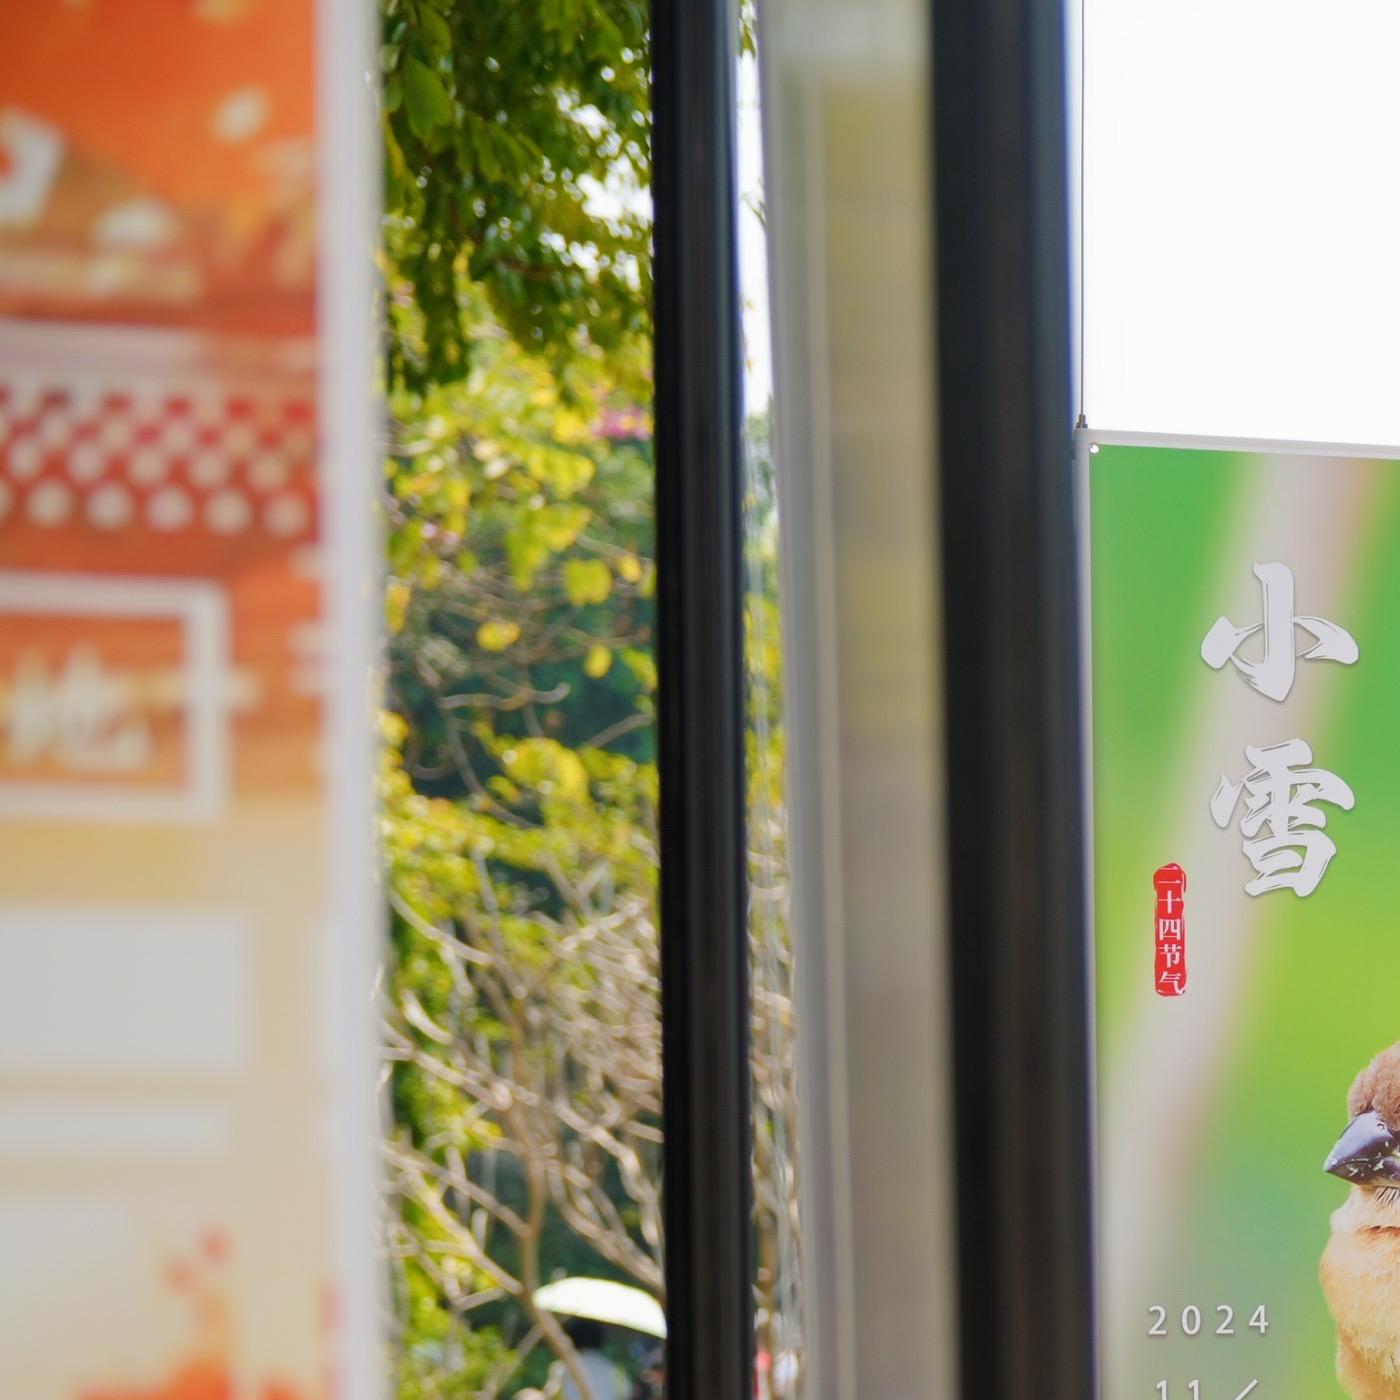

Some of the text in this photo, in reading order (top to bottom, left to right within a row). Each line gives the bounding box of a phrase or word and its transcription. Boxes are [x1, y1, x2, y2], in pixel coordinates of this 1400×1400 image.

[1200, 560, 1360, 898] 小雪
[1157, 865, 1186, 995] 二十四节气
[1148, 1304, 1270, 1335] 2024
